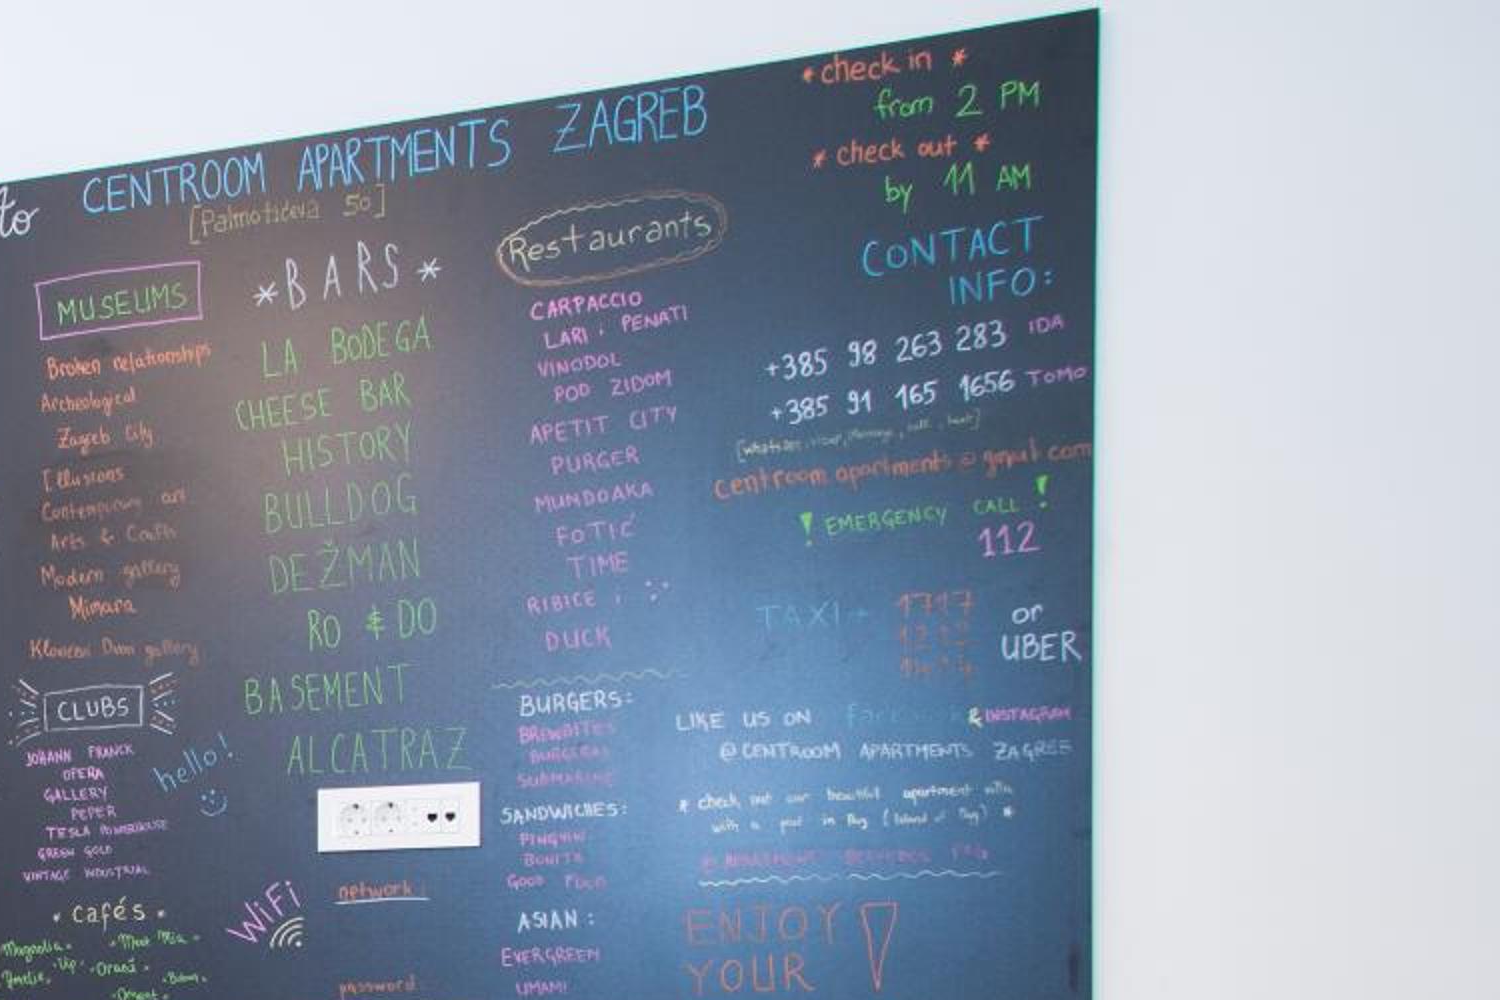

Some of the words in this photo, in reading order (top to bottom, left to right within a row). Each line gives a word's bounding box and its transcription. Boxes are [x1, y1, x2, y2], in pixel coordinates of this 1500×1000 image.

[820, 52, 901, 84] check
[908, 50, 933, 72] in
[873, 88, 934, 121] from
[956, 84, 984, 117] 2
[999, 80, 1041, 110] PM
[82, 151, 267, 214] CENTROOM
[296, 119, 512, 192] APARTMENTS
[552, 84, 709, 153] ZAGREB
[835, 138, 905, 167] check
[917, 135, 958, 158] out
[884, 175, 914, 215] by
[942, 161, 976, 195] 11
[995, 163, 1033, 192] AM
[509, 210, 713, 272] Restaurants
[862, 216, 1045, 277] CONTACT
[55, 280, 188, 327] MUSEUMS
[949, 266, 1053, 305] INFO:
[529, 290, 644, 322] CARPACCIO
[260, 338, 298, 378] LA
[330, 314, 431, 365] BODEGA
[543, 326, 590, 350] LARI
[620, 303, 689, 334] PENATI
[46, 356, 102, 382] Broken
[112, 339, 213, 377] relationships
[536, 351, 623, 378] VINODOL
[764, 347, 829, 381] +385
[847, 338, 879, 369] 98
[895, 329, 944, 364] 263
[954, 318, 1008, 353] 283
[1028, 313, 1066, 335] IDA
[235, 386, 332, 432] CHEESE
[359, 371, 412, 412] BAR
[553, 382, 592, 402] POD
[610, 368, 674, 397] ZIDOM
[771, 393, 830, 426] +385
[847, 388, 873, 416] 91
[895, 378, 940, 411] 165
[959, 368, 1017, 403] 1656
[1025, 365, 1089, 386] TOMO
[56, 424, 113, 458] Zagreb
[529, 414, 610, 446] APETIT
[628, 404, 678, 432] CITY
[281, 418, 414, 478] HISTORY
[550, 445, 642, 476] PURGER
[264, 471, 418, 535] BULLDOG
[534, 481, 655, 514] MUNDOAKA
[824, 504, 948, 537] EMERGENCY
[972, 496, 1021, 516] CALL
[977, 519, 1041, 558] 112
[565, 550, 630, 580] TIME
[307, 608, 342, 651] RO
[397, 597, 438, 640] DO
[1011, 603, 1044, 625] or
[544, 623, 613, 652] DUCK
[1000, 630, 1083, 663] UBER
[244, 661, 418, 715] BASEMENT
[518, 688, 634, 718] BURGERS:
[56, 694, 130, 723] CLUBS
[675, 710, 726, 733] LIKE
[741, 711, 772, 729] US
[781, 707, 813, 728] ON
[287, 726, 473, 775] ALCATRAZ
[858, 740, 975, 762] APARTMENTS
[43, 785, 109, 805] GALLERY
[499, 799, 629, 826] SANDWICHES:
[45, 825, 92, 842] TESLA
[225, 879, 303, 945] WiFi
[683, 900, 843, 947] ENJOY
[500, 946, 601, 968] EVERGREEN
[685, 951, 818, 996] YOUR
